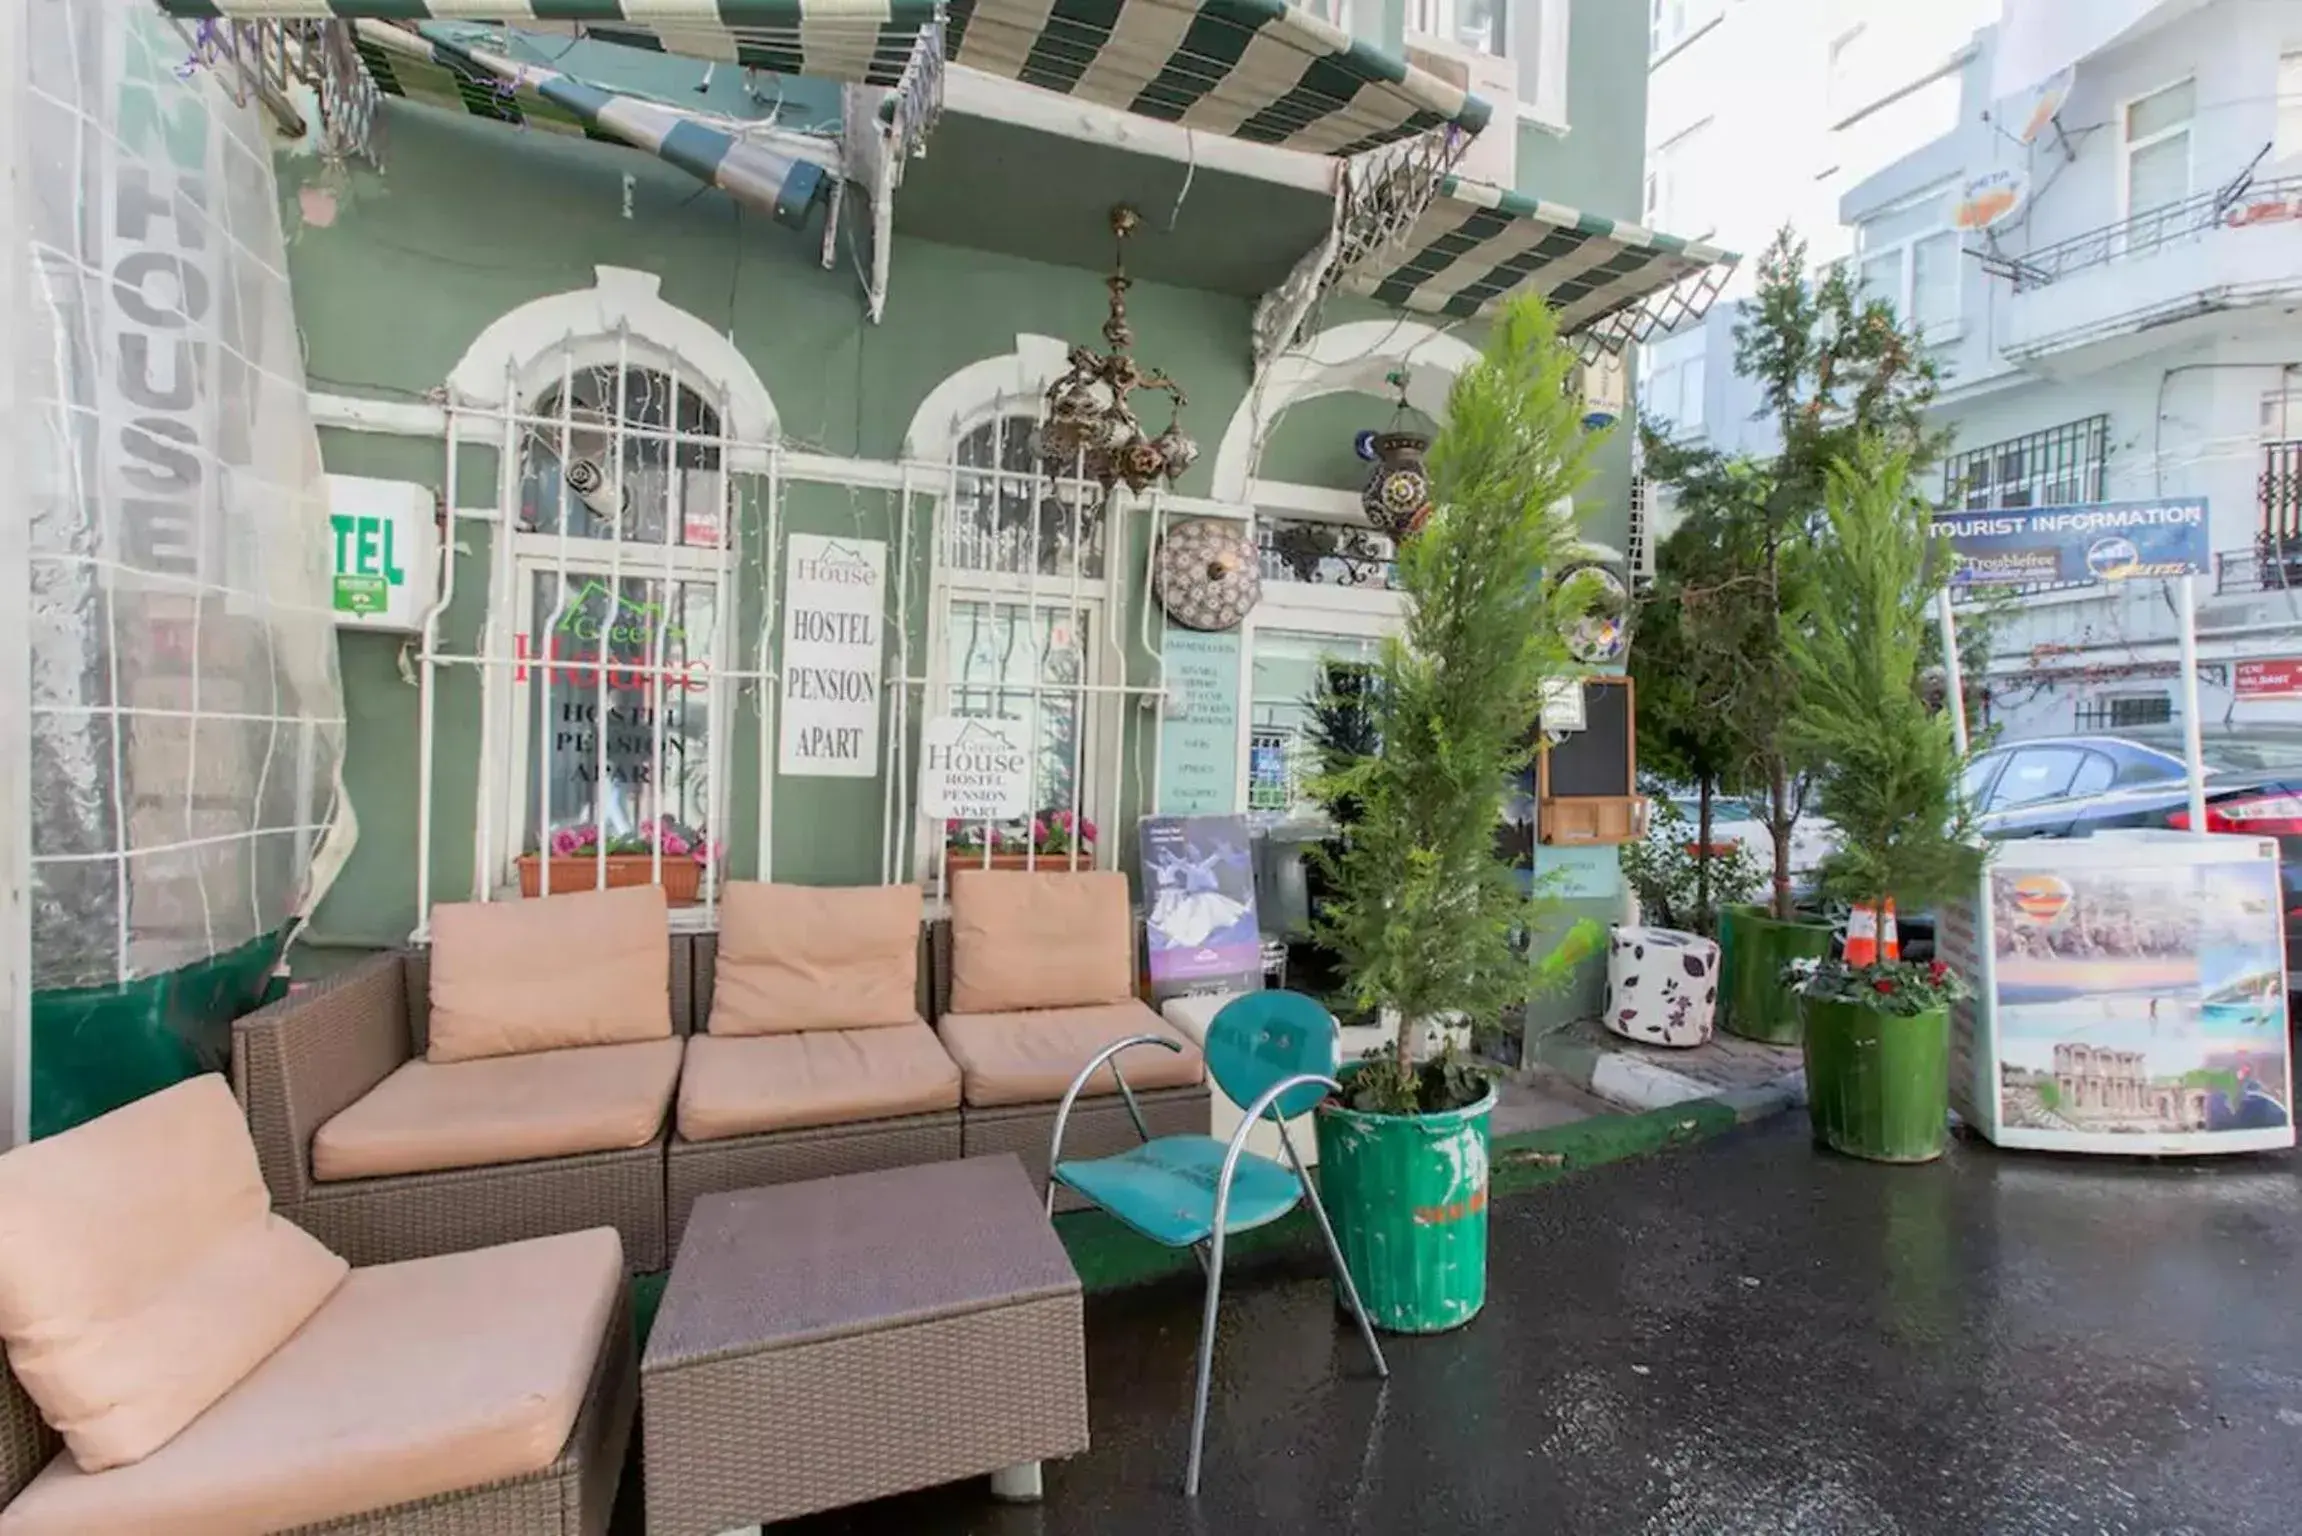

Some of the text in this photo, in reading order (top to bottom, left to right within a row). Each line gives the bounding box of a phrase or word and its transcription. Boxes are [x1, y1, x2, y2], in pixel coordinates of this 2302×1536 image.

[1928, 506, 2202, 539] TOURIST INFORMATION
[798, 557, 877, 587] House
[792, 608, 876, 645] HOSTEL
[787, 666, 875, 704] PENSION
[556, 732, 685, 755] PESION
[794, 727, 864, 760] APART
[570, 762, 671, 783] APAR
[929, 744, 1025, 774] House
[943, 788, 1006, 801] PENSION
[945, 774, 1006, 786] HOSTEL
[952, 805, 999, 818] APART
